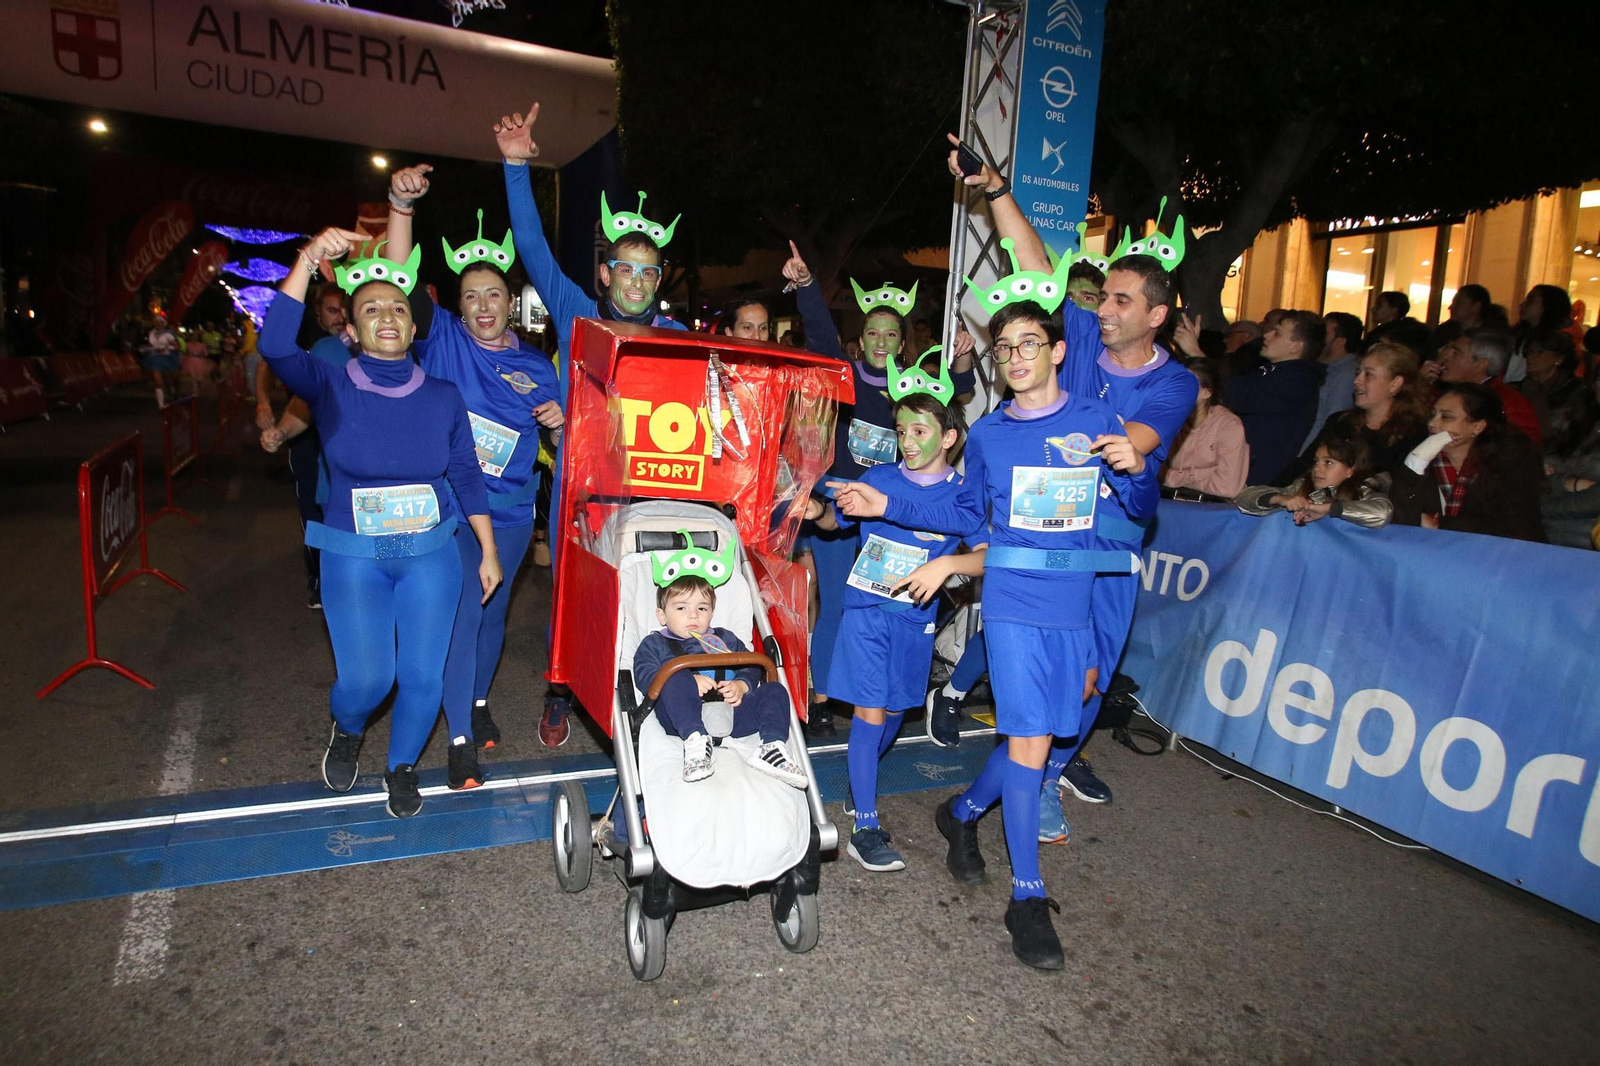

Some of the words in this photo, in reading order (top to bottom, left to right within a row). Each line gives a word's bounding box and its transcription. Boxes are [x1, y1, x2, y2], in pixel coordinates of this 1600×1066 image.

[186, 6, 447, 92] ALMERÍA
[186, 59, 325, 106] CIUDAD
[1045, 110, 1066, 123] OPEL
[1022, 174, 1032, 184] DS
[1033, 176, 1080, 192] AUTOMOBILES
[1032, 201, 1064, 215] GRUPO
[1056, 220, 1075, 232] CAR
[607, 397, 732, 456] TOY
[477, 434, 505, 454] 421
[636, 461, 695, 480] STORY
[1053, 486, 1087, 503] 425
[392, 500, 427, 518] 417
[884, 558, 918, 576] 427
[1203, 628, 1600, 868] depor
